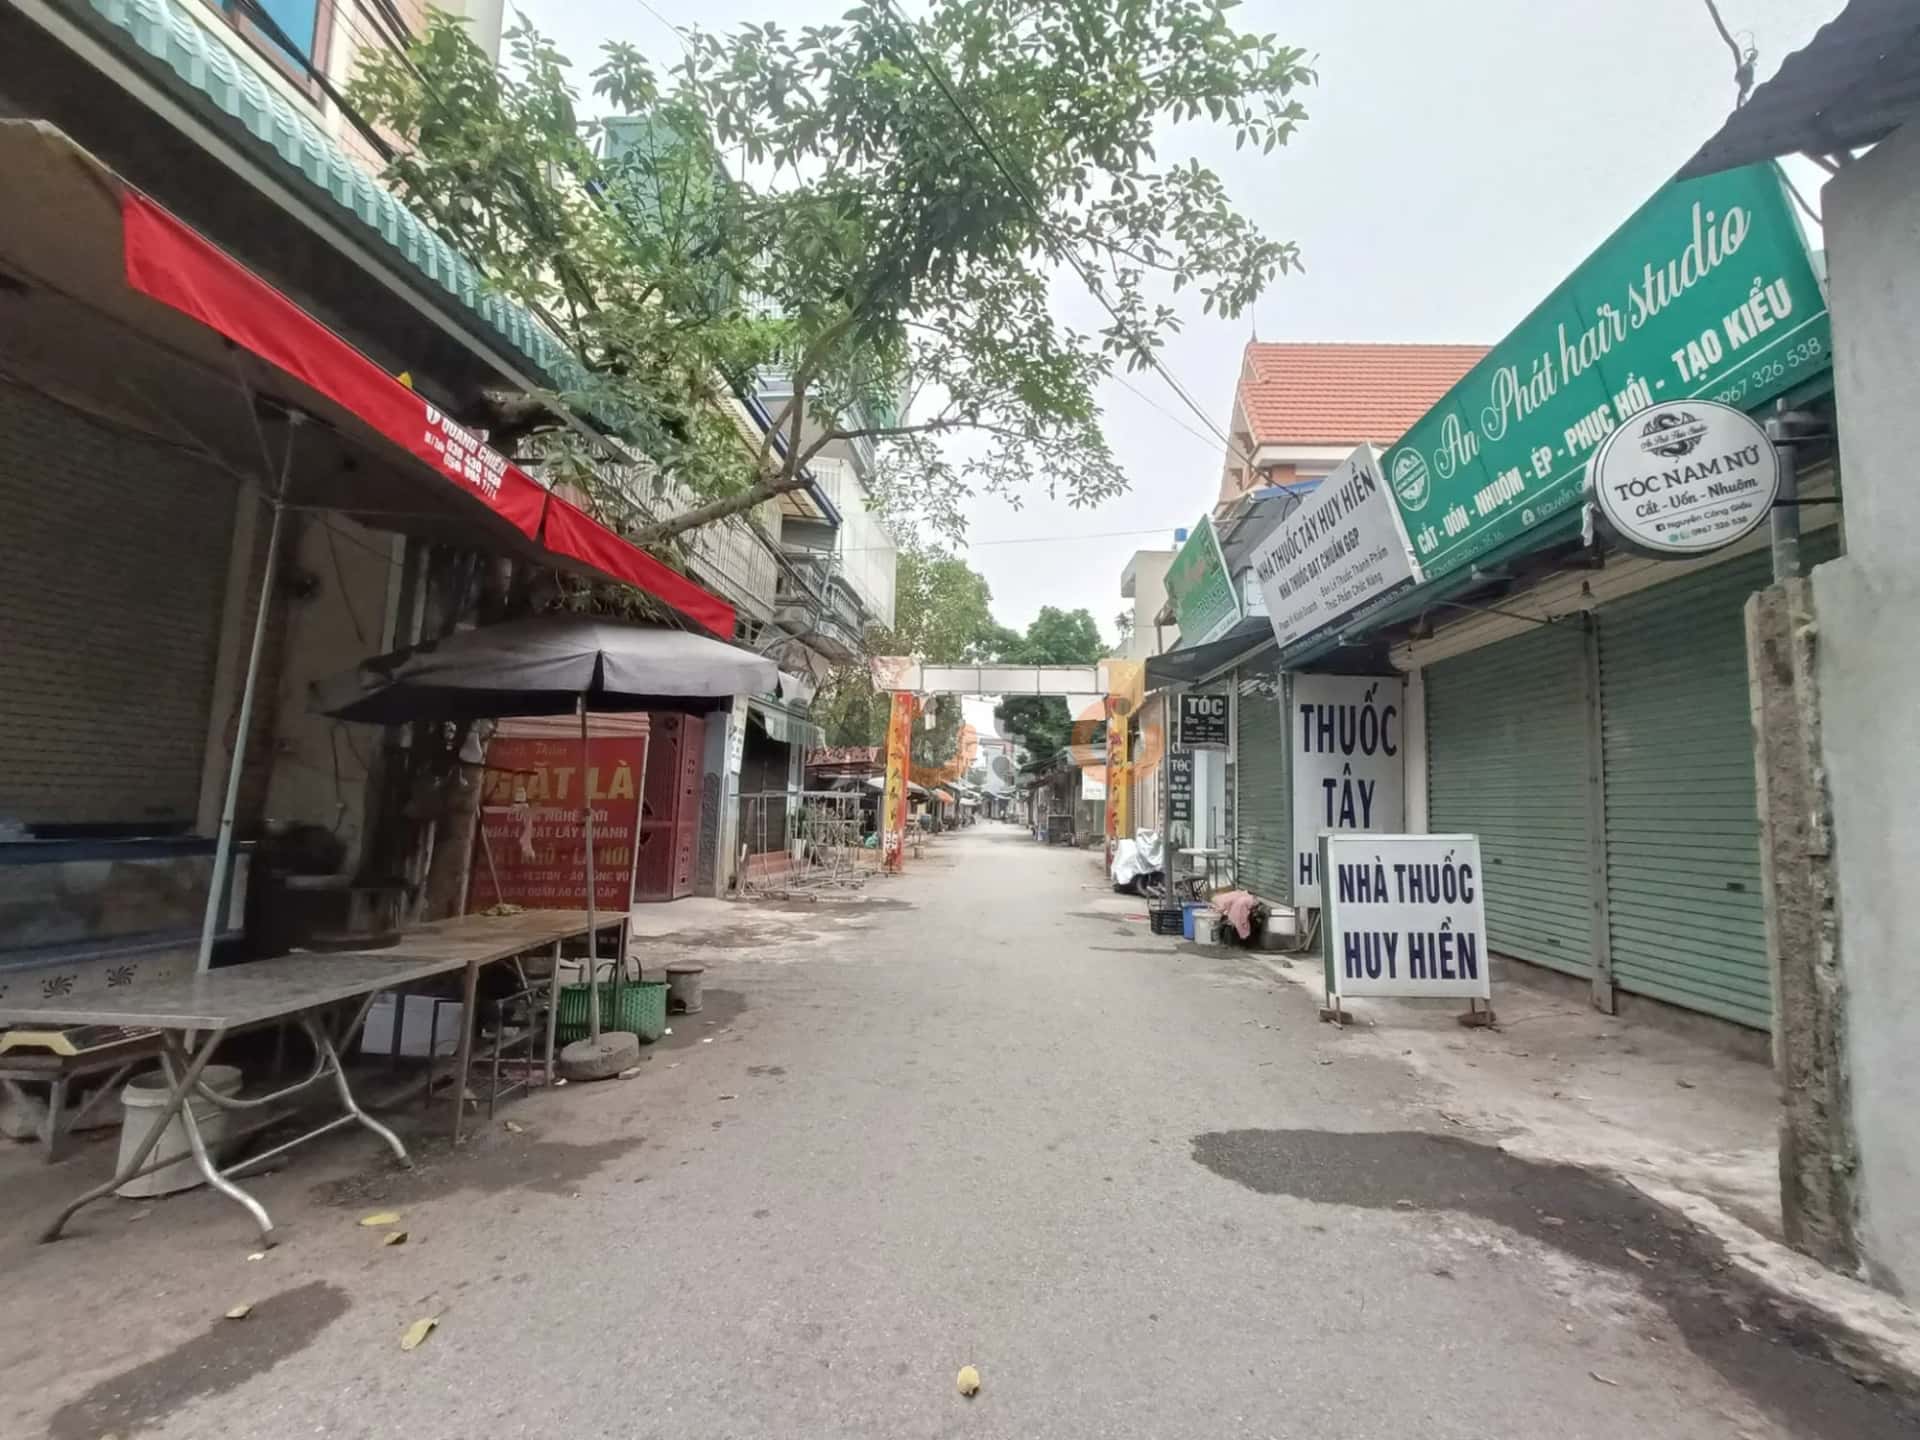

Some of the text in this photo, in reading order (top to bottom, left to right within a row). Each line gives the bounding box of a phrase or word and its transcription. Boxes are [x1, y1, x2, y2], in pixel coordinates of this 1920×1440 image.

[1433, 200, 1751, 480] An Phát hair studio
[1752, 360, 1785, 388] 326
[1786, 337, 1821, 368] 538
[1473, 467, 1525, 517] NHUỘM
[1531, 447, 1552, 479] ÉP
[1671, 328, 1723, 384] TẠO
[1722, 276, 1793, 350] KIỂU
[1615, 475, 1661, 501] TÓC
[1663, 458, 1722, 488] NAM
[1724, 444, 1760, 471] NỮ
[1669, 490, 1698, 509] Uốn
[1707, 478, 1758, 498] Nhuộm
[1256, 550, 1276, 582] NHÀ
[1271, 525, 1303, 572] THUỐC
[1299, 514, 1319, 549] TÂY
[1317, 493, 1342, 534] HUY
[1187, 694, 1224, 715] TÓC
[1300, 681, 1398, 757] THUỐC
[585, 759, 634, 800] LÀ
[1322, 762, 1376, 829] TÂY
[1338, 849, 1474, 904] NHÀ THUỐC
[1344, 931, 1398, 980] HUY
